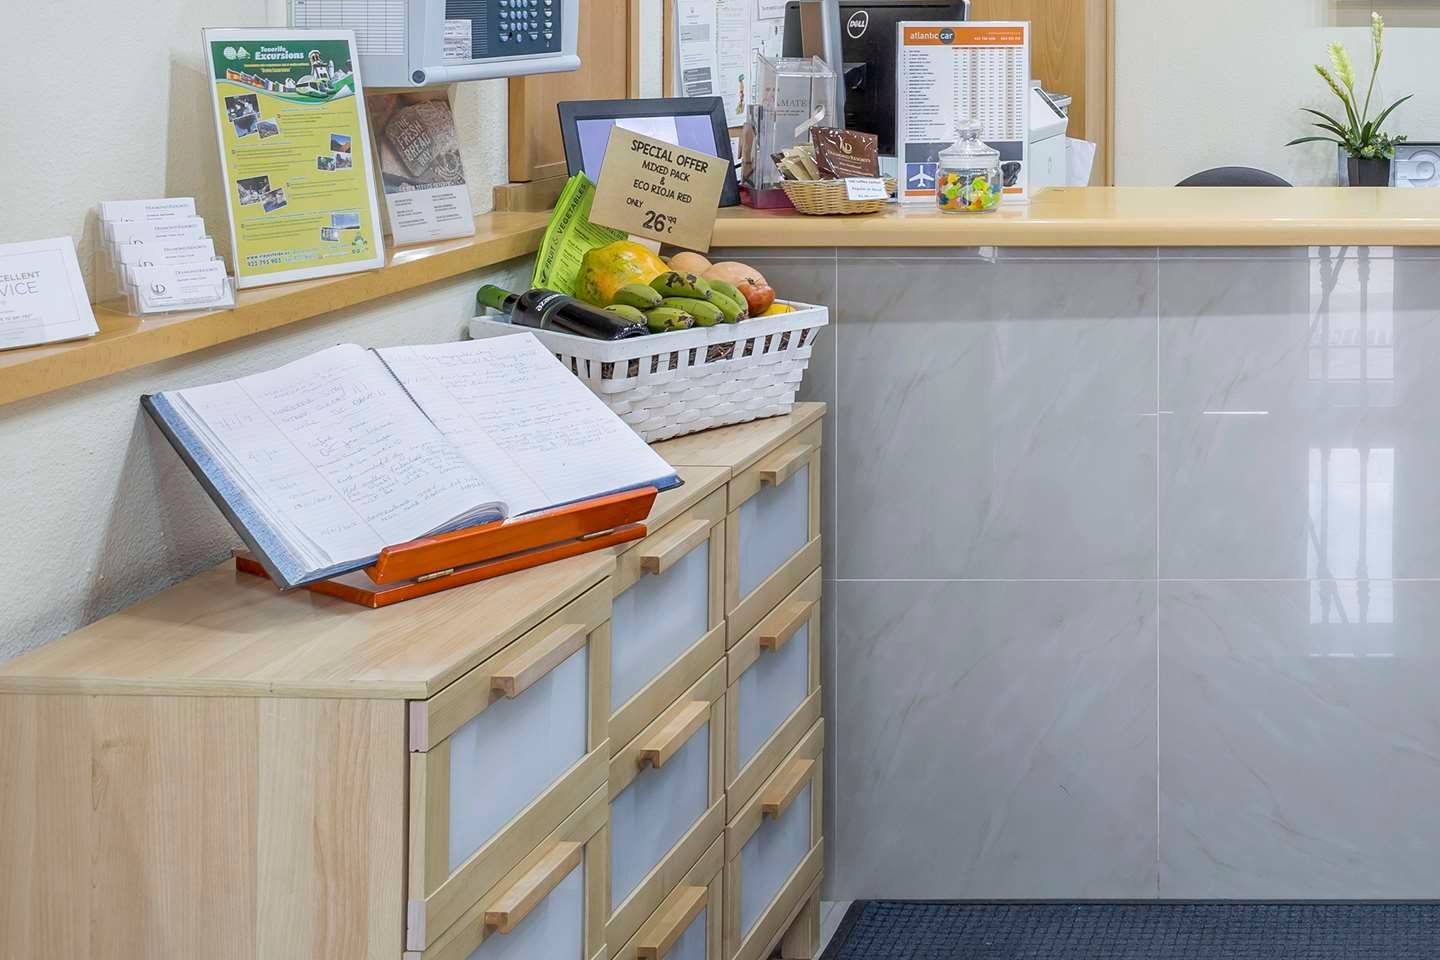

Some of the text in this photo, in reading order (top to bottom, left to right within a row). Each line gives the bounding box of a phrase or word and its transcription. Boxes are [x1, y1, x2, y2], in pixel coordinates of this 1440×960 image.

[909, 31, 938, 40] atlantic
[255, 51, 305, 60] Excursions
[260, 45, 287, 53] Tenerife
[400, 120, 425, 149] FRESH
[404, 132, 432, 161] BREAD
[631, 139, 709, 173] SPECIAL OFFER
[642, 160, 691, 182] MIXED PACK
[660, 176, 665, 185] &
[626, 197, 645, 208] ONLY
[633, 179, 692, 204] ECO RIOJA RED
[545, 246, 557, 269] FRUIT
[557, 183, 586, 235] VEGETABLES
